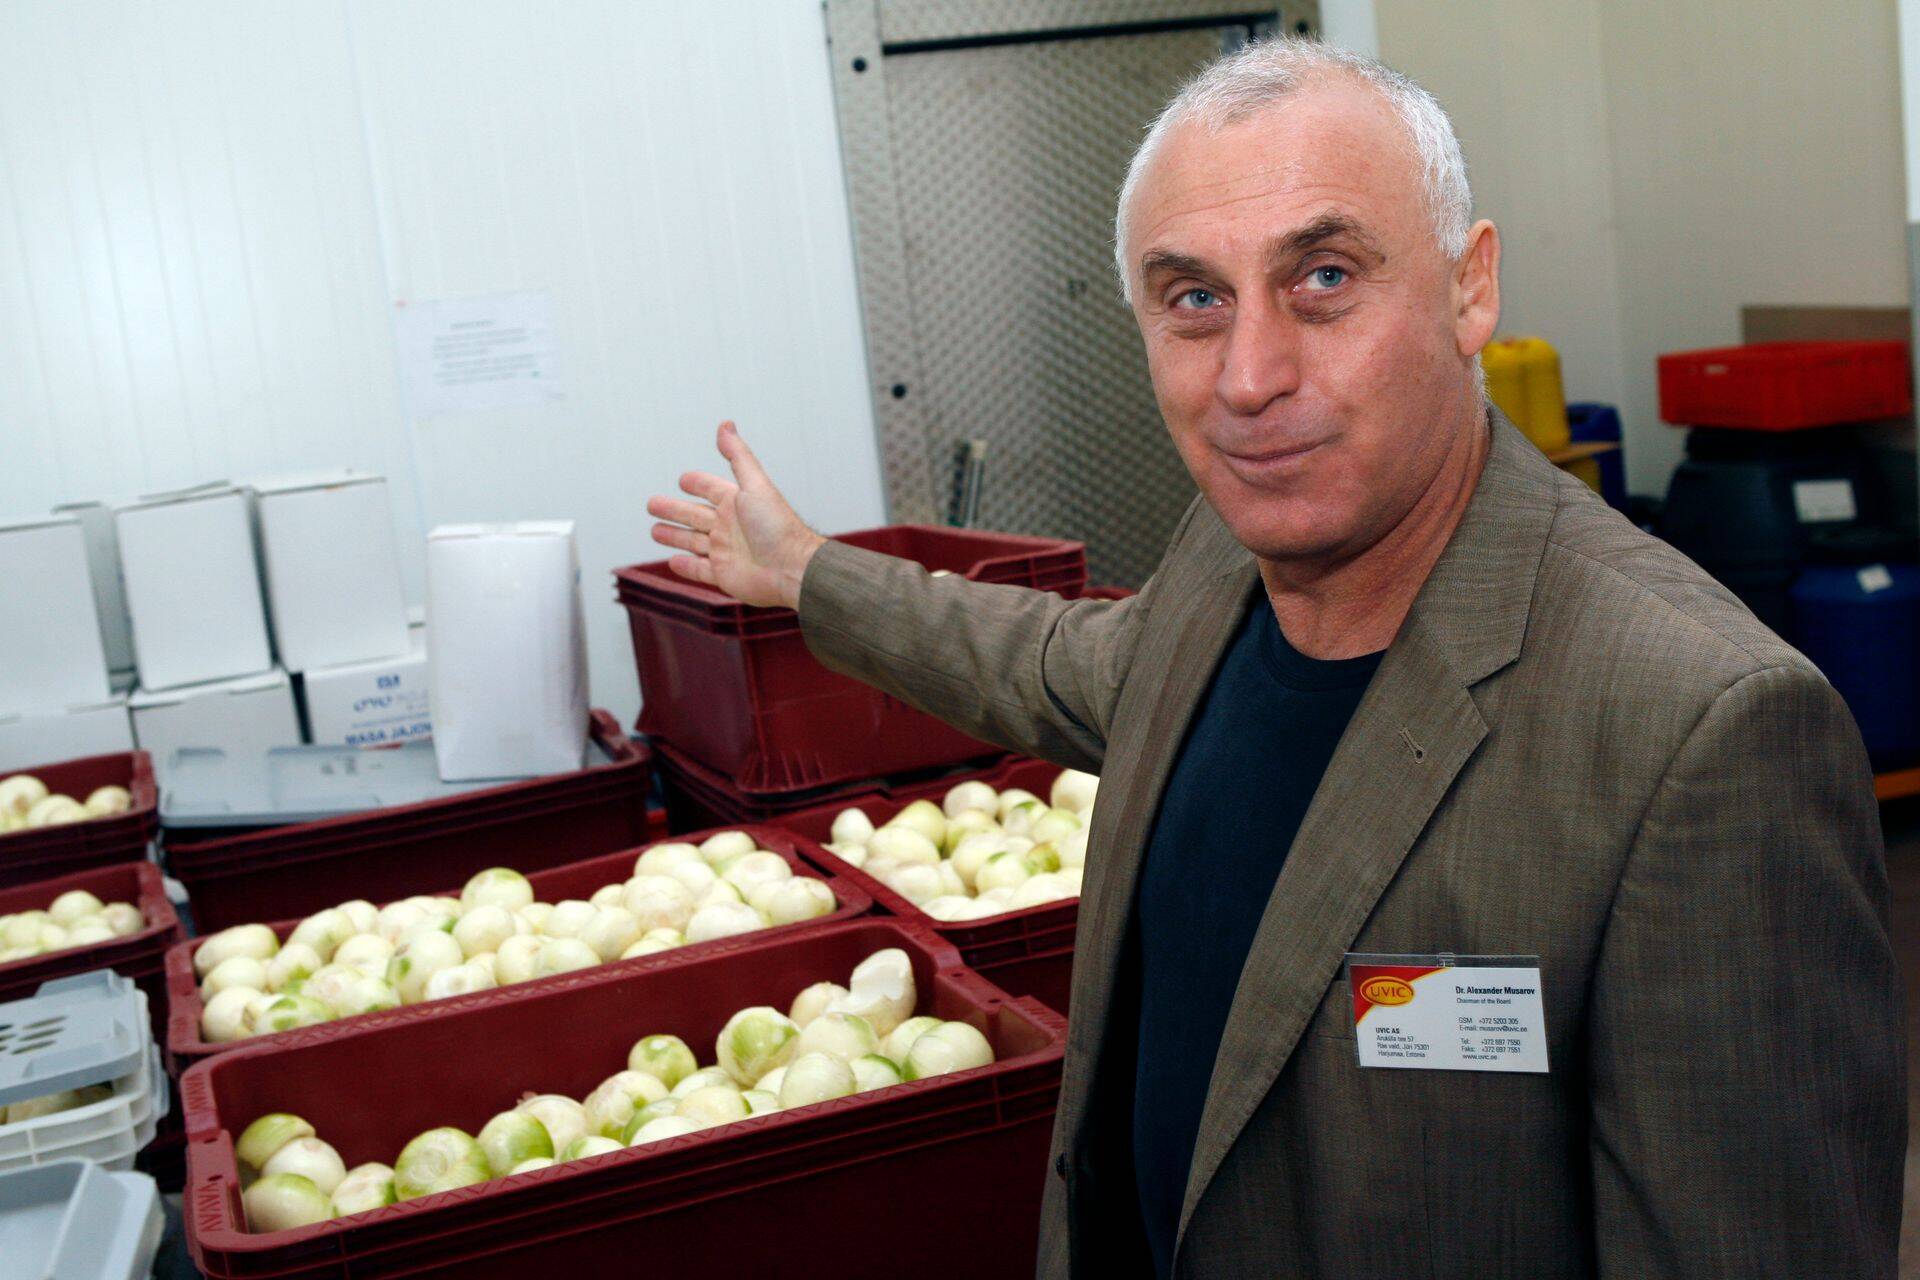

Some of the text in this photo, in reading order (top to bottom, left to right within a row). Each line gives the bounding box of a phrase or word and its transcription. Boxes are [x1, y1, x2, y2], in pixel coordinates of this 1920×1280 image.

[1370, 986, 1407, 998] UVIC
[1455, 986, 1535, 995] Dr. Alexander Musarov
